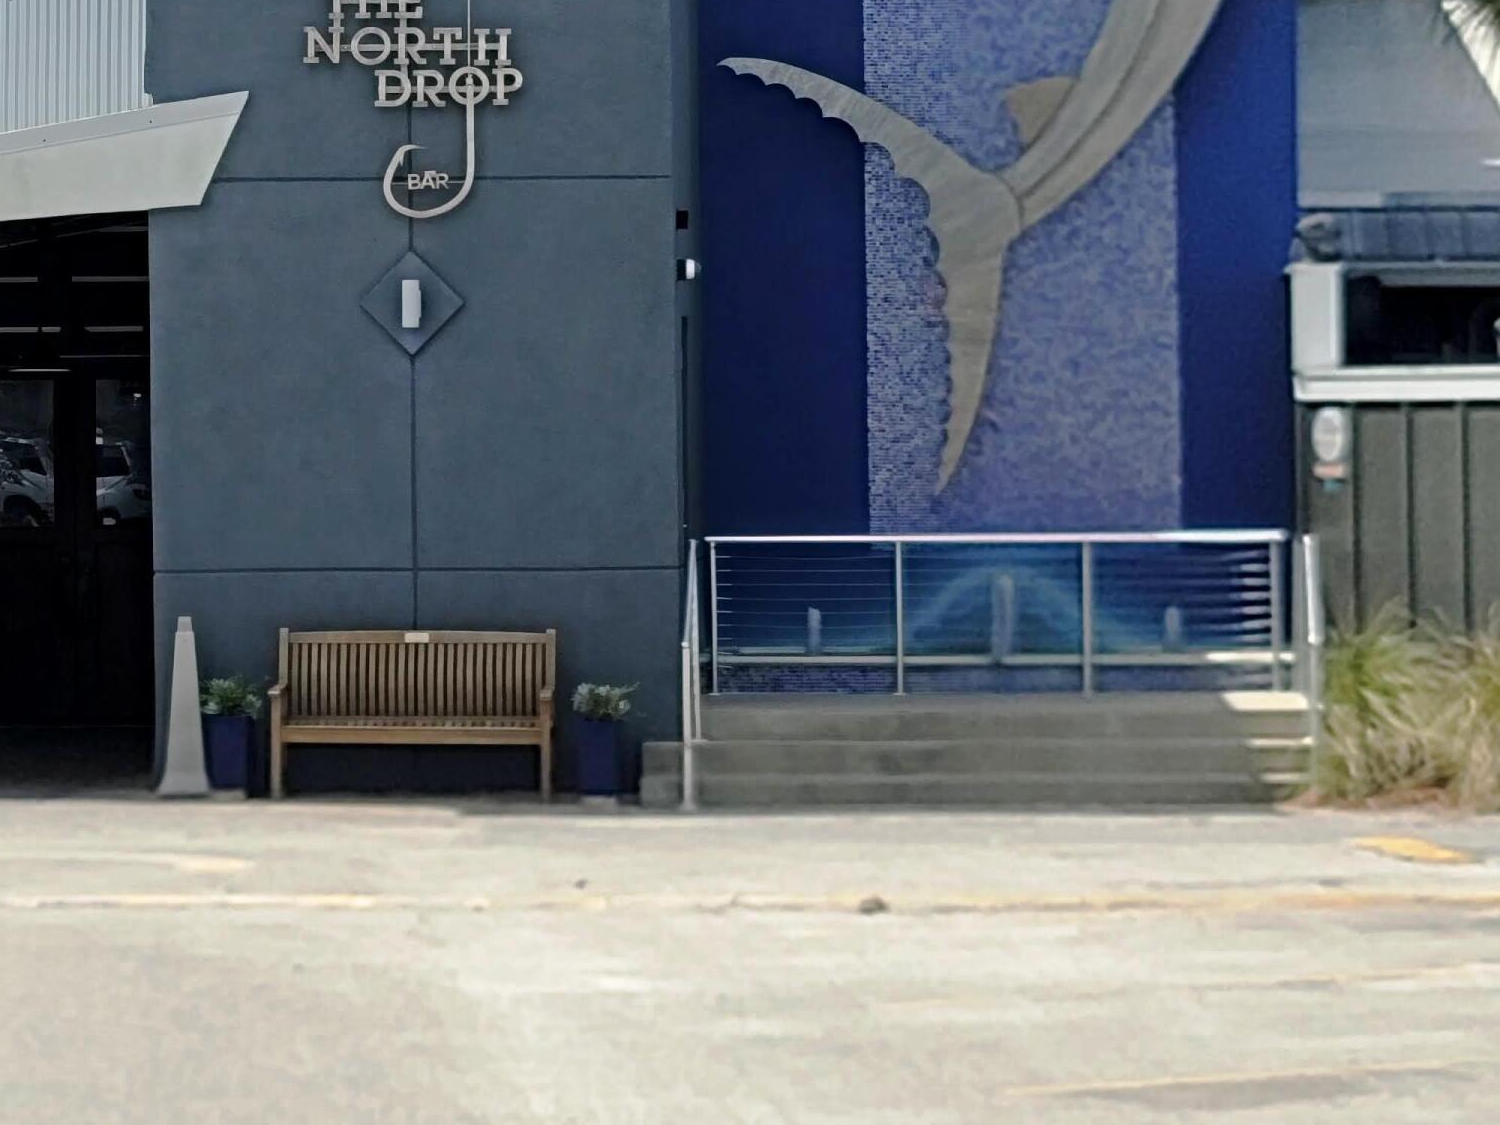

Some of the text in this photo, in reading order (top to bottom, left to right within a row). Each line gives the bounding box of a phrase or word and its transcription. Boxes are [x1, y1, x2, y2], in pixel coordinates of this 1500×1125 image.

[303, 26, 512, 66] NORTH
[374, 65, 524, 108] DROP
[407, 171, 450, 191] BAR
